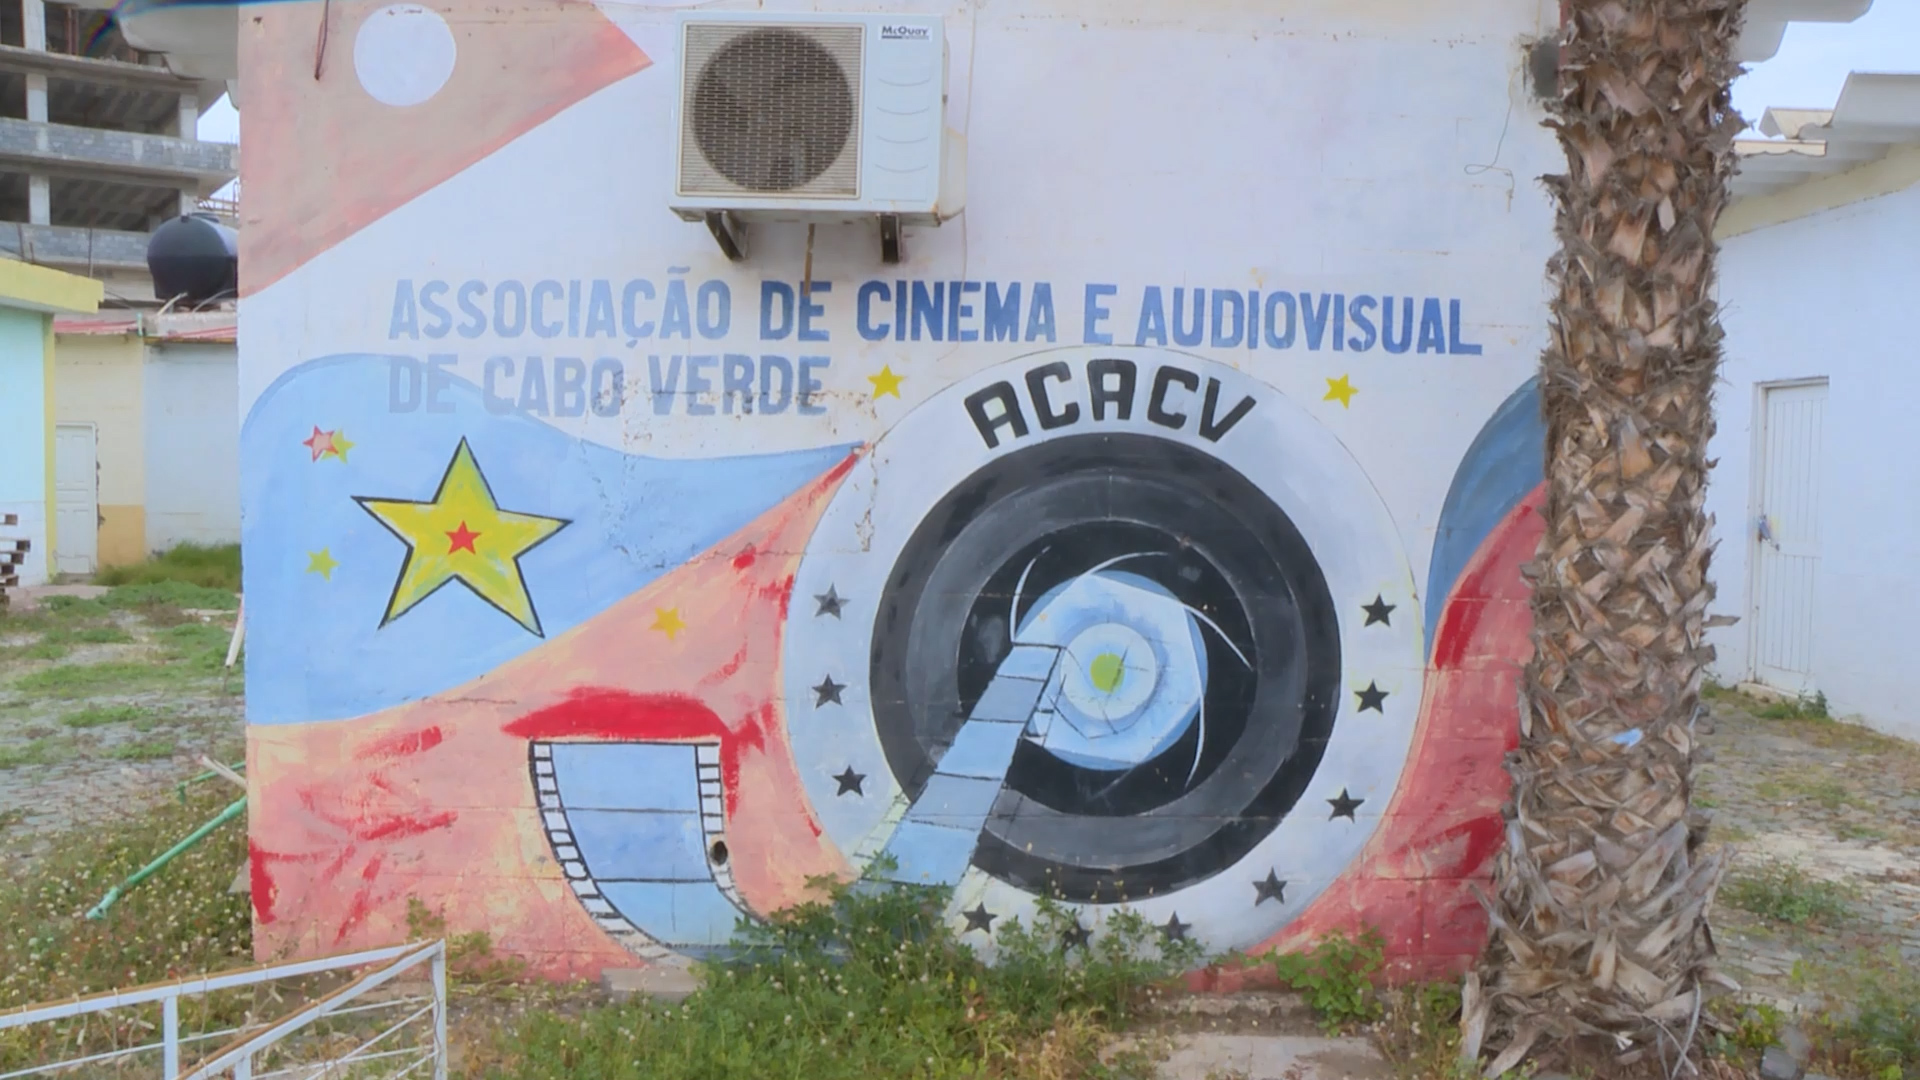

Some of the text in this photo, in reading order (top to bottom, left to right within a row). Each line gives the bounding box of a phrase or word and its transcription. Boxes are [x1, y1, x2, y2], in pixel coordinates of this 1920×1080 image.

[388, 266, 1483, 355] ASSOCIAÇÃO DE CINEMA E AUDIOVISUAL
[388, 354, 831, 417] DE CABO VERDE
[964, 358, 1256, 449] ACACV
